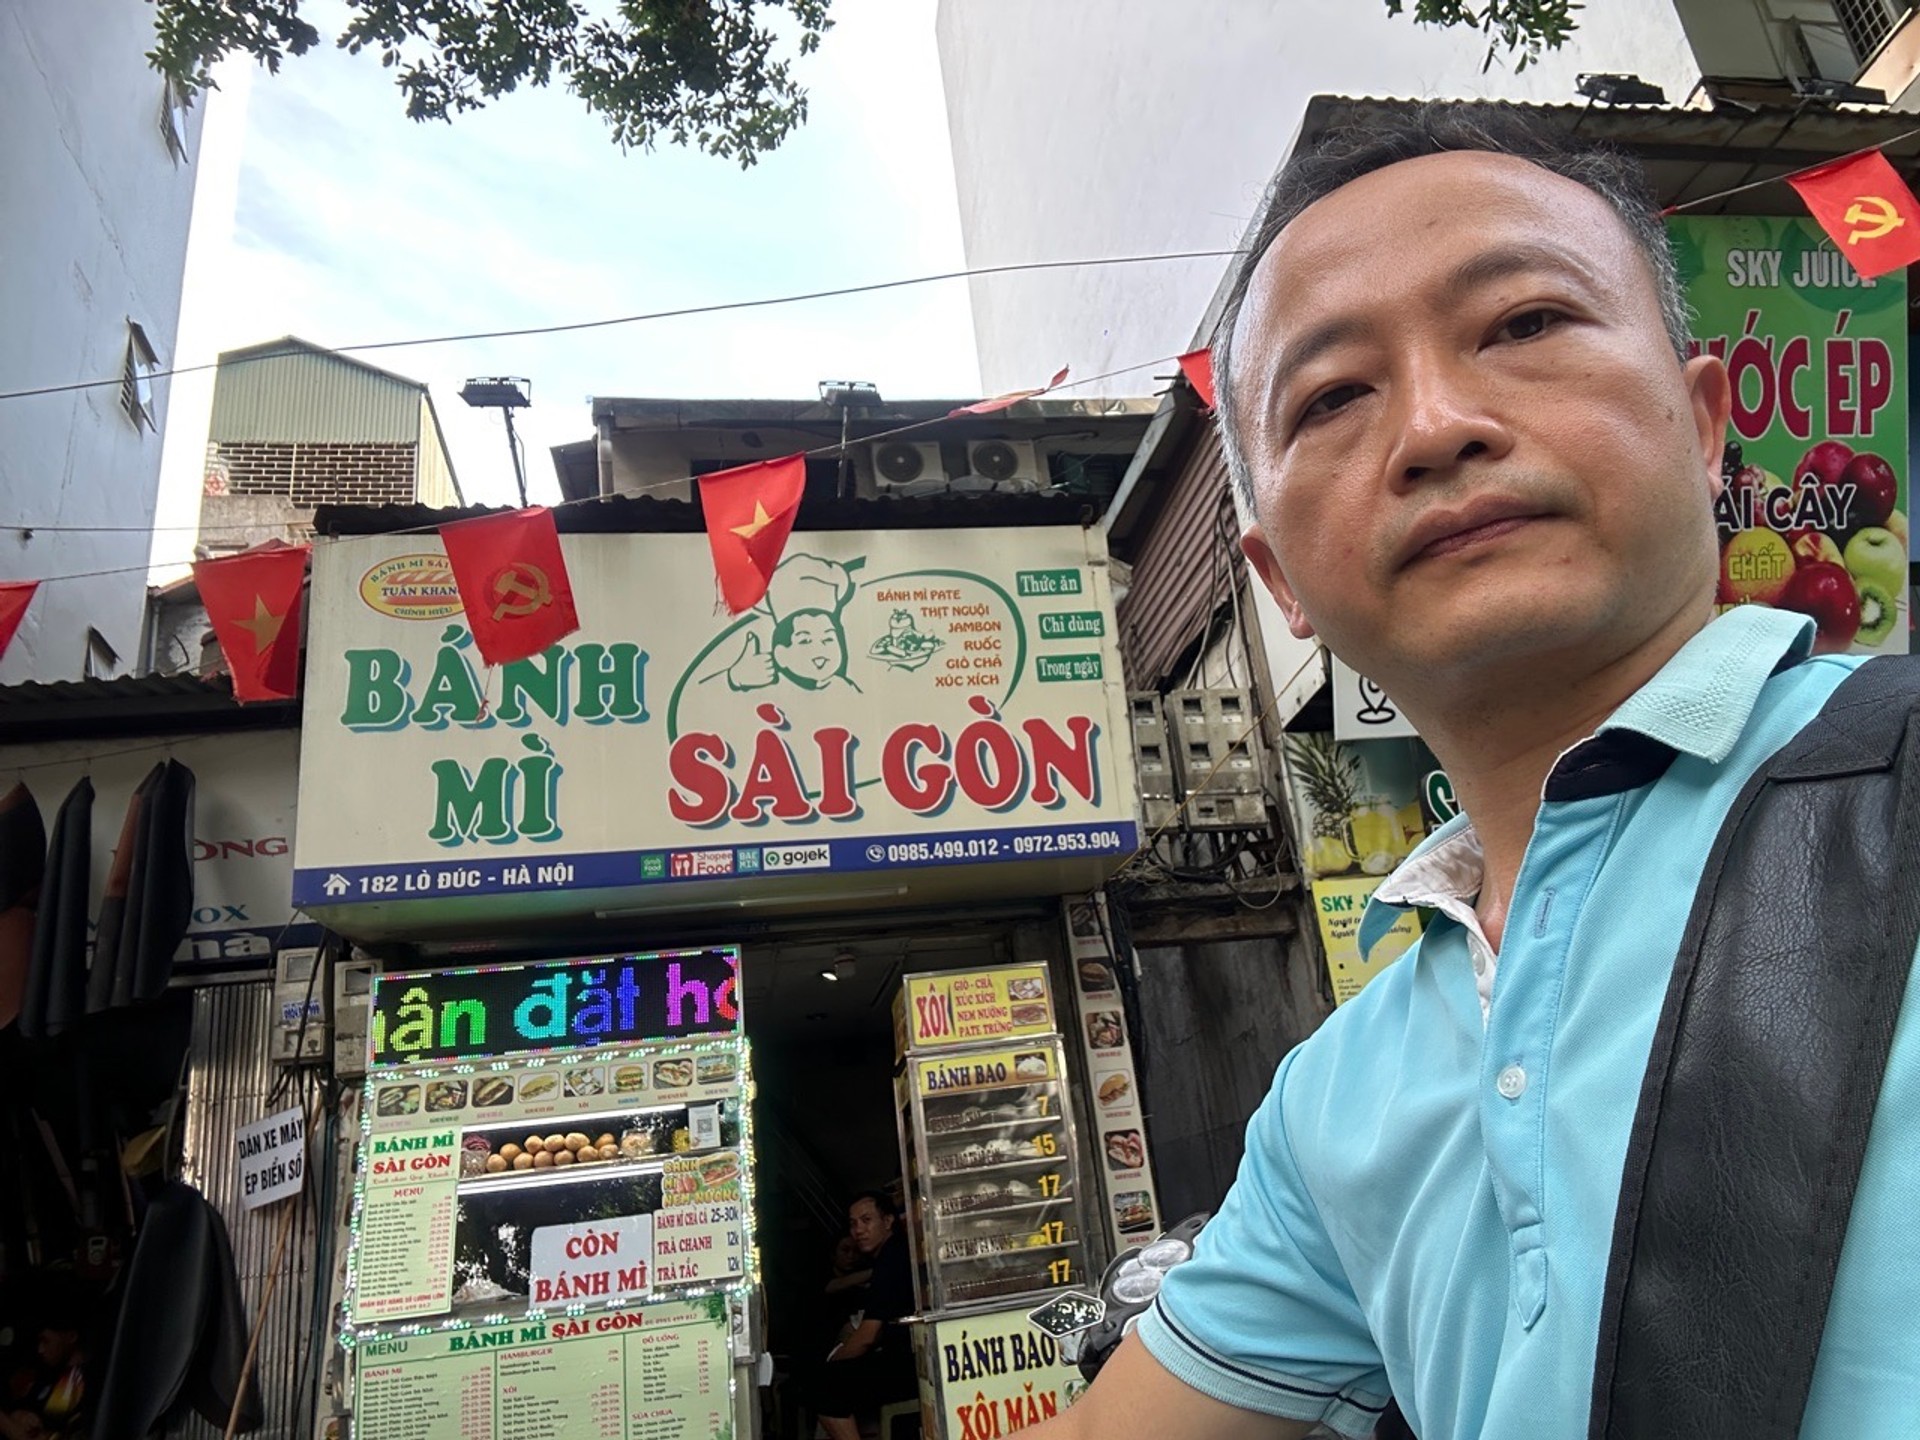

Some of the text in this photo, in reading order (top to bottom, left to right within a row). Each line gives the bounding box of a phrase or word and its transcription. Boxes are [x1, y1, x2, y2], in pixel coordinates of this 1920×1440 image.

[1727, 249, 1783, 288] SKY
[1825, 309, 1894, 438] ÉP
[1765, 473, 1857, 532] CÂY
[370, 562, 406, 583] BÁNH
[1728, 543, 1786, 581] CHẤT
[421, 586, 458, 596] KHAN
[877, 587, 911, 602] BÁNH
[930, 588, 961, 601] PATE
[1020, 573, 1079, 593] Thức ăn
[394, 606, 426, 616] CHÍNH
[920, 602, 990, 620] THỊT NGUỘI
[948, 620, 1002, 634] JAMBON
[1068, 614, 1101, 635] dùng
[963, 635, 1002, 652] RUỐC
[946, 655, 970, 670] GIÒ
[1038, 655, 1100, 680] Trong ngày
[341, 623, 651, 734] BÁNH
[935, 672, 1000, 688] XÚC XÍCH
[667, 694, 1101, 830] SÀI GÒN
[428, 732, 564, 848] MÌ
[697, 851, 733, 863] Shopee
[783, 847, 828, 866] gojek
[887, 838, 998, 862] 0985.499.012
[1013, 830, 1121, 854] 0972.953.904
[697, 861, 733, 874] Food
[739, 860, 759, 870] MIN
[358, 875, 399, 894] 182
[404, 868, 431, 892] LÒ
[437, 867, 482, 890] ĐÚC
[502, 863, 531, 886] HÀ
[537, 861, 575, 887] NỘI
[1321, 895, 1353, 913] SKY
[513, 966, 641, 1046] đặt
[916, 982, 949, 1039] XÔI
[957, 1009, 976, 1021] NEM
[959, 1025, 981, 1038] PATE
[926, 1062, 1007, 1090] BÁNH BAO
[1037, 1095, 1049, 1116] 7
[238, 1116, 303, 1160] DÁN XE MÁY
[373, 1130, 455, 1154] BÁNH MÌ
[1031, 1133, 1056, 1156] 15
[244, 1147, 303, 1196] ÉP BIỂN SỐ
[373, 1152, 452, 1175] SÀI GÒN
[393, 1187, 424, 1198] MENU
[1038, 1174, 1061, 1198] 17
[565, 1228, 619, 1260] CÒN
[657, 1235, 677, 1255] TRÀ
[679, 1235, 713, 1253] CHANH
[1040, 1221, 1064, 1245] 17
[657, 1261, 678, 1281] TRÀ
[679, 1256, 699, 1278] TẮC
[1048, 1259, 1071, 1284] 17
[534, 1260, 648, 1303] BÁNH MÌ
[366, 1340, 408, 1357] MENU
[449, 1330, 515, 1352] BÁNH
[520, 1322, 547, 1342] MÌ
[551, 1318, 591, 1340] SÀI
[595, 1312, 644, 1331] GÒN
[500, 1347, 553, 1361] HAMBURGER
[944, 1329, 1057, 1383] BÁNH BAO
[956, 1390, 1003, 1440] XÔI
